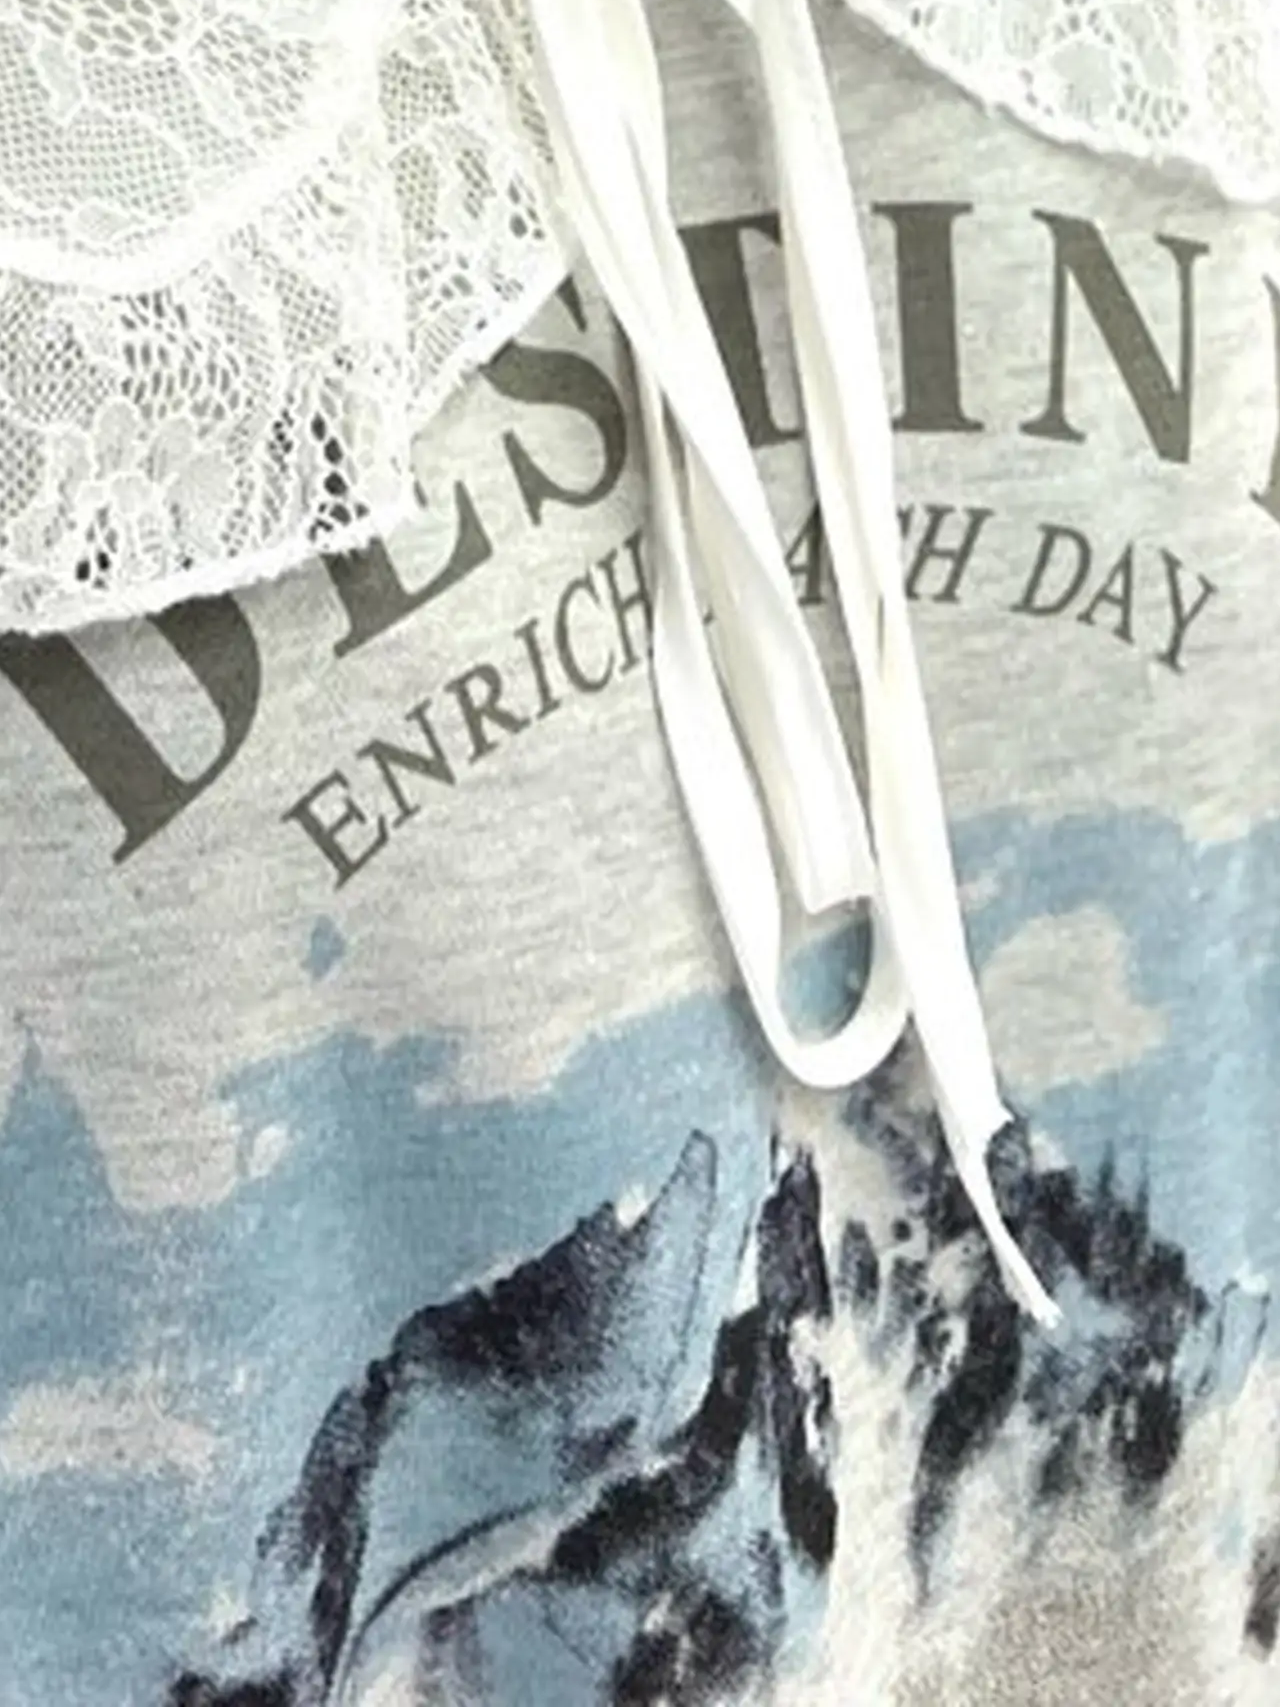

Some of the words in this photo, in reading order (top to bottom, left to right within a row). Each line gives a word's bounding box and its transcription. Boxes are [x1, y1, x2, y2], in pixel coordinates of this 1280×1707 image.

[281, 529, 654, 889] ENRICH
[702, 503, 995, 627] AH
[1010, 522, 1217, 673] DAY
